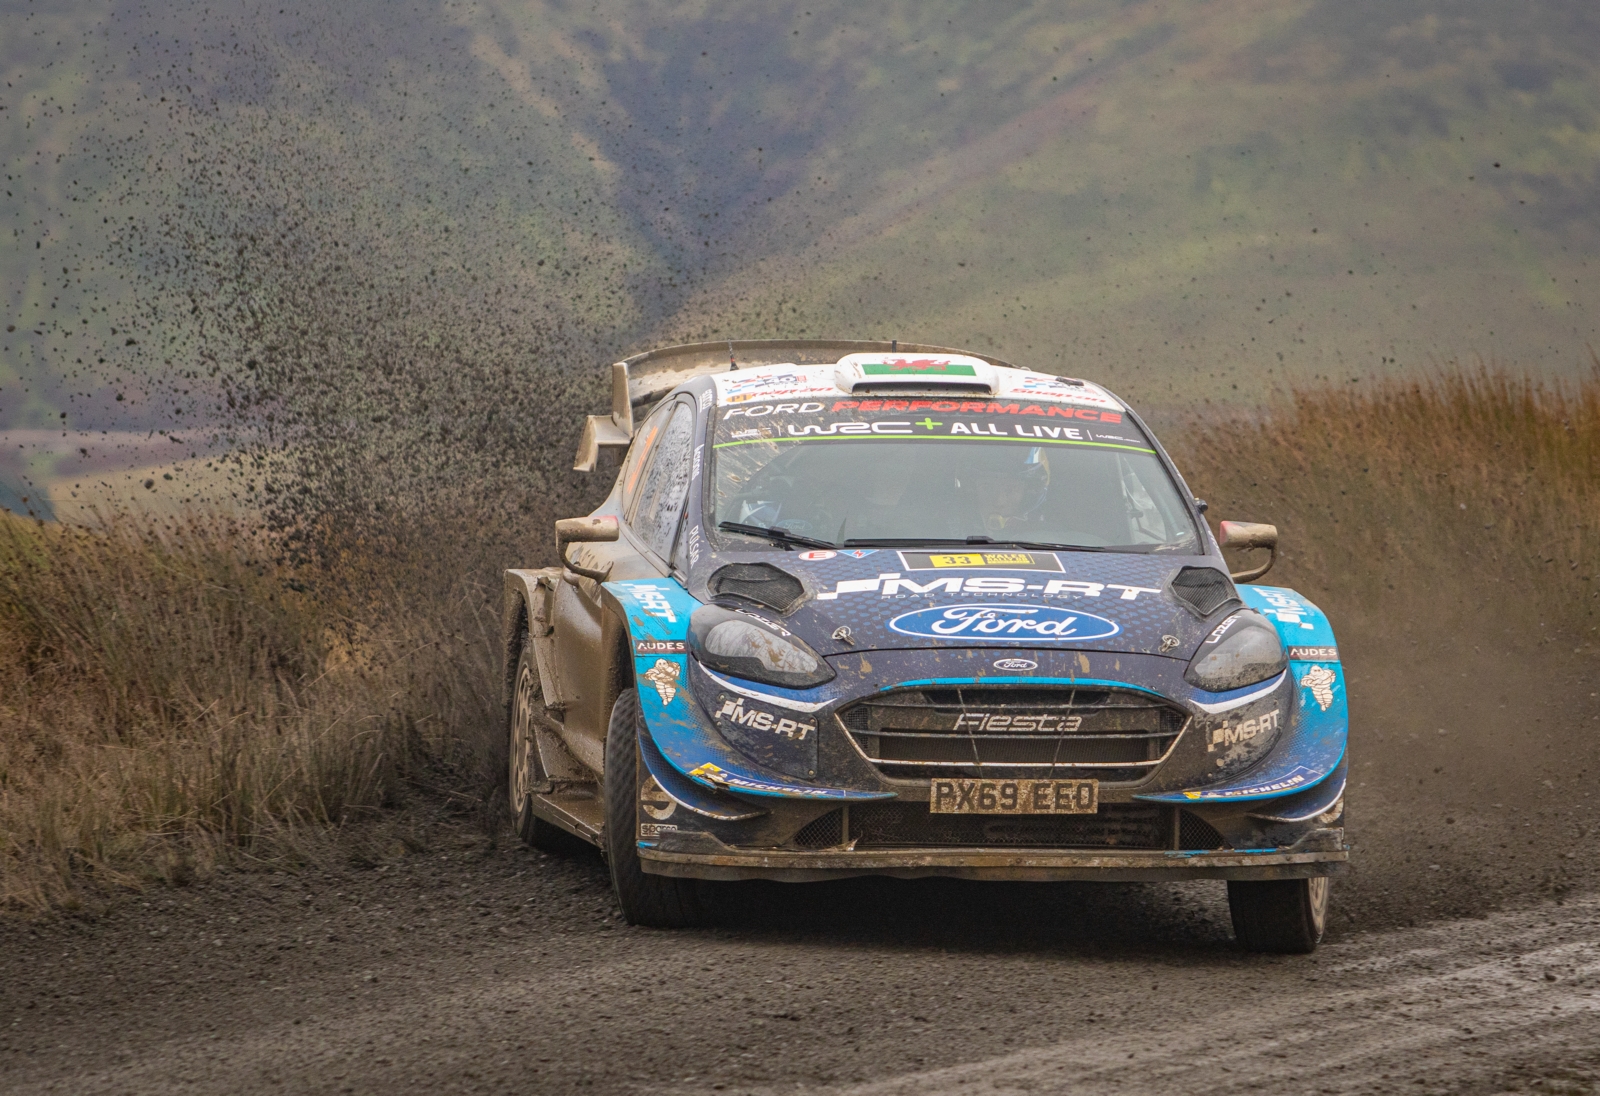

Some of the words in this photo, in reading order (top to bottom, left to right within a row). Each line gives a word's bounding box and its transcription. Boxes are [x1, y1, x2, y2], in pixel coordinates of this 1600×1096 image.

[723, 402, 824, 420] FORD
[831, 400, 1122, 423] PERFORMANCE
[951, 422, 1008, 435] ALL
[1015, 424, 1083, 440] LIVE
[808, 551, 827, 559] E
[942, 555, 972, 565] 33
[882, 577, 1162, 601] MS-RT
[948, 592, 1082, 600] TECHNOLOGY
[931, 606, 1077, 635] Ford
[637, 642, 685, 650] AUDES
[1290, 648, 1337, 656] AUDES
[730, 704, 816, 740] MS-RT
[952, 712, 1083, 732] Fiesta
[1223, 708, 1281, 746] MS-RT
[727, 777, 829, 795] MICHELIN
[1224, 774, 1306, 796] MICHELIN
[934, 782, 1018, 810] PX69
